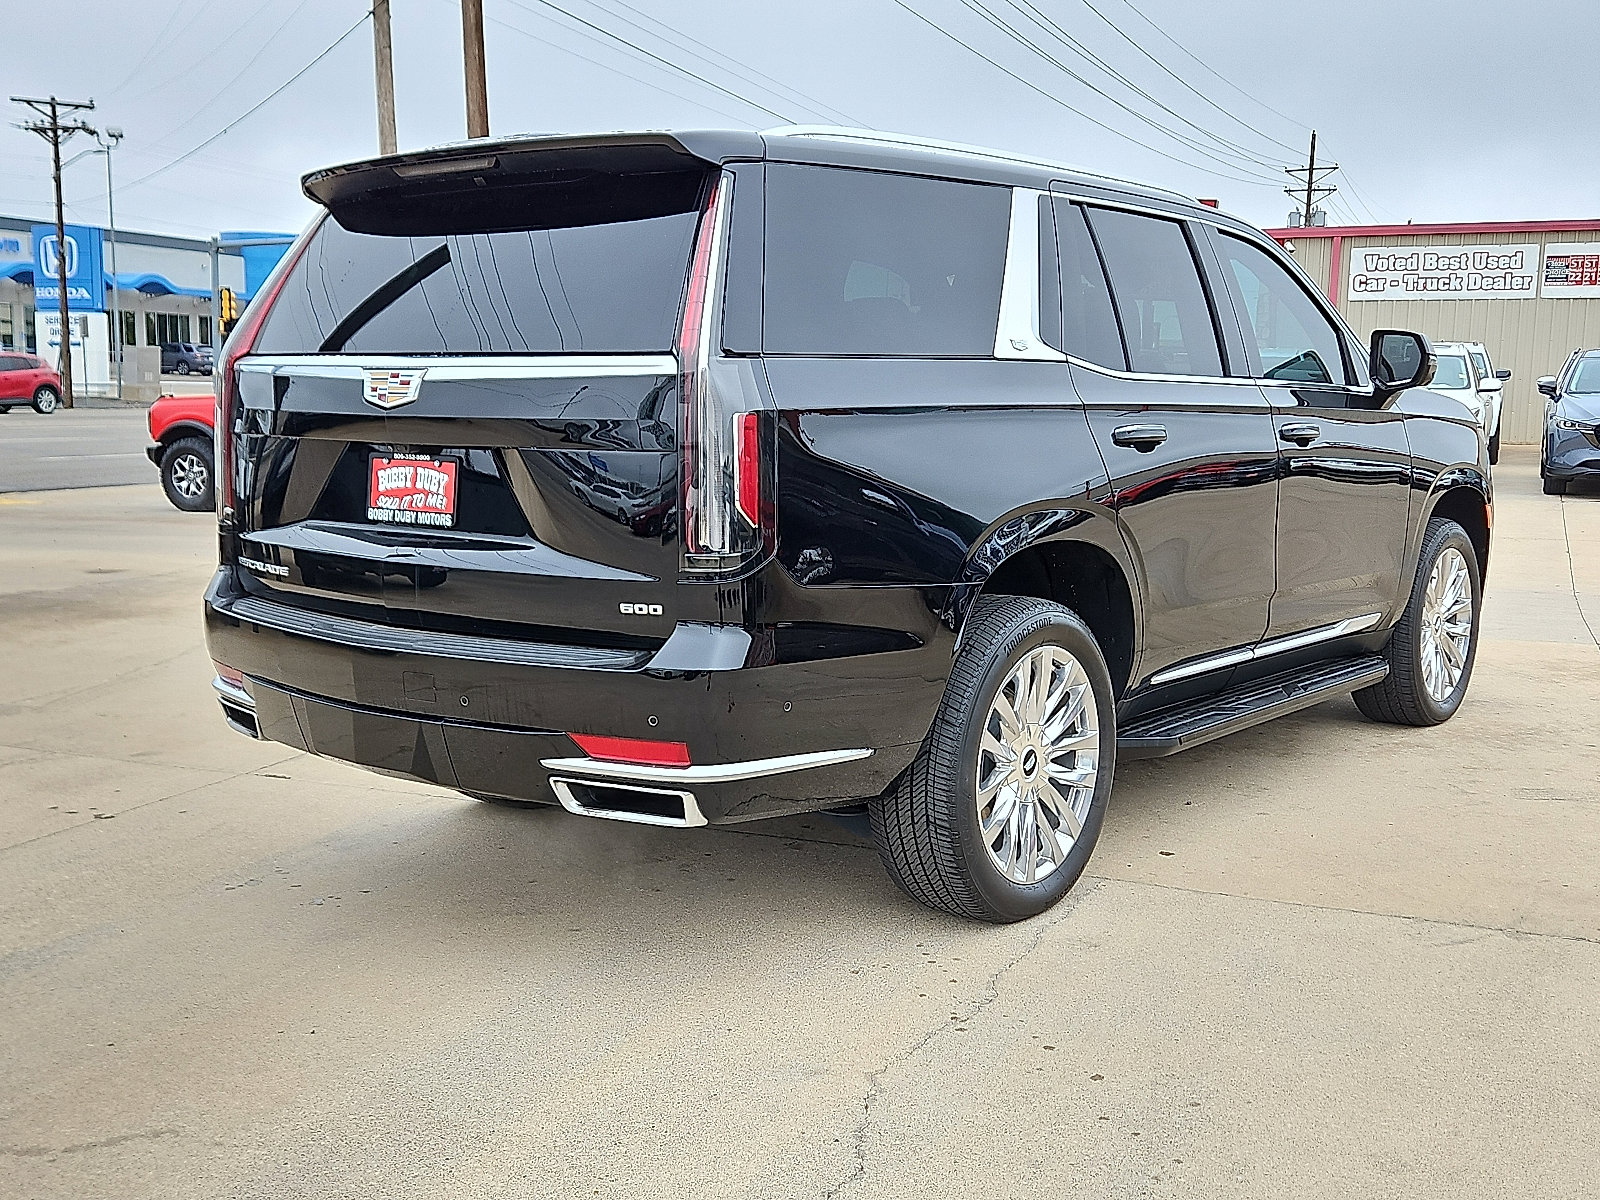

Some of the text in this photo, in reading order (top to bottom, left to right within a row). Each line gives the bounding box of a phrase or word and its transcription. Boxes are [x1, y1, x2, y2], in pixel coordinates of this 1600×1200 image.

[1365, 251, 1524, 272] Voted Best Used
[1353, 274, 1387, 292] Car
[1402, 273, 1465, 291] Truck
[1467, 272, 1533, 291] Dealer
[1570, 272, 1582, 280] 22
[1584, 272, 1596, 280] 21
[377, 466, 449, 496] BOBBY DUBY
[376, 494, 400, 509] SOLD
[400, 495, 412, 510] IT
[412, 493, 425, 508] TO
[368, 508, 453, 527] BOBBY DUBY MOTORS
[619, 603, 663, 615] 600
[1002, 616, 1053, 658] BRIDGESTONE
